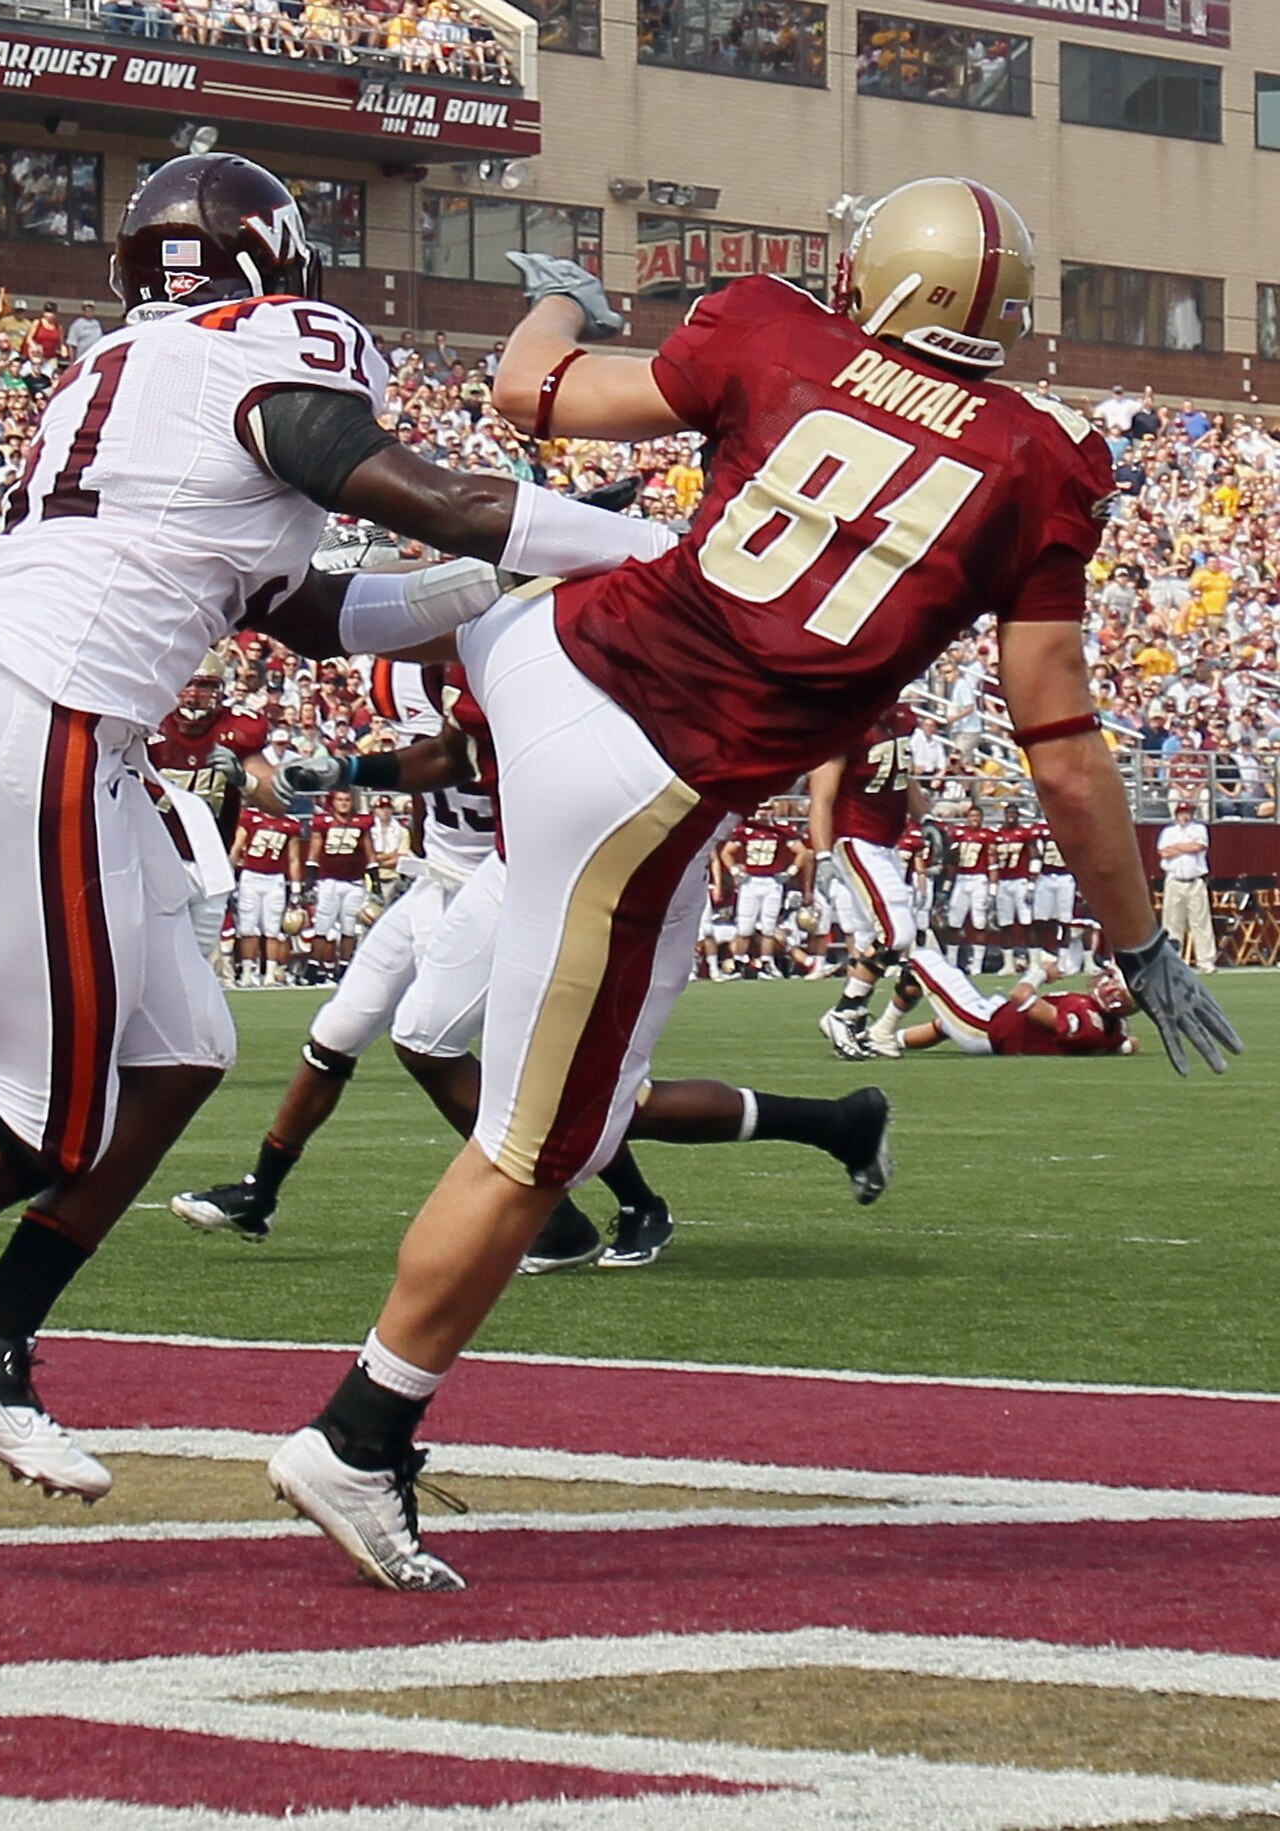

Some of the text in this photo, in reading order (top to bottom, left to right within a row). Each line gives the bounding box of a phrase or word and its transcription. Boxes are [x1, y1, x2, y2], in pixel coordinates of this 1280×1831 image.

[123, 57, 198, 90] BOWL
[356, 92, 508, 128] ALOHA BOWL
[927, 285, 958, 309] 81
[293, 308, 371, 389] 51
[831, 350, 988, 439] PANTALE
[697, 408, 985, 647] 81
[247, 829, 288, 861] 54
[324, 827, 362, 855] 55
